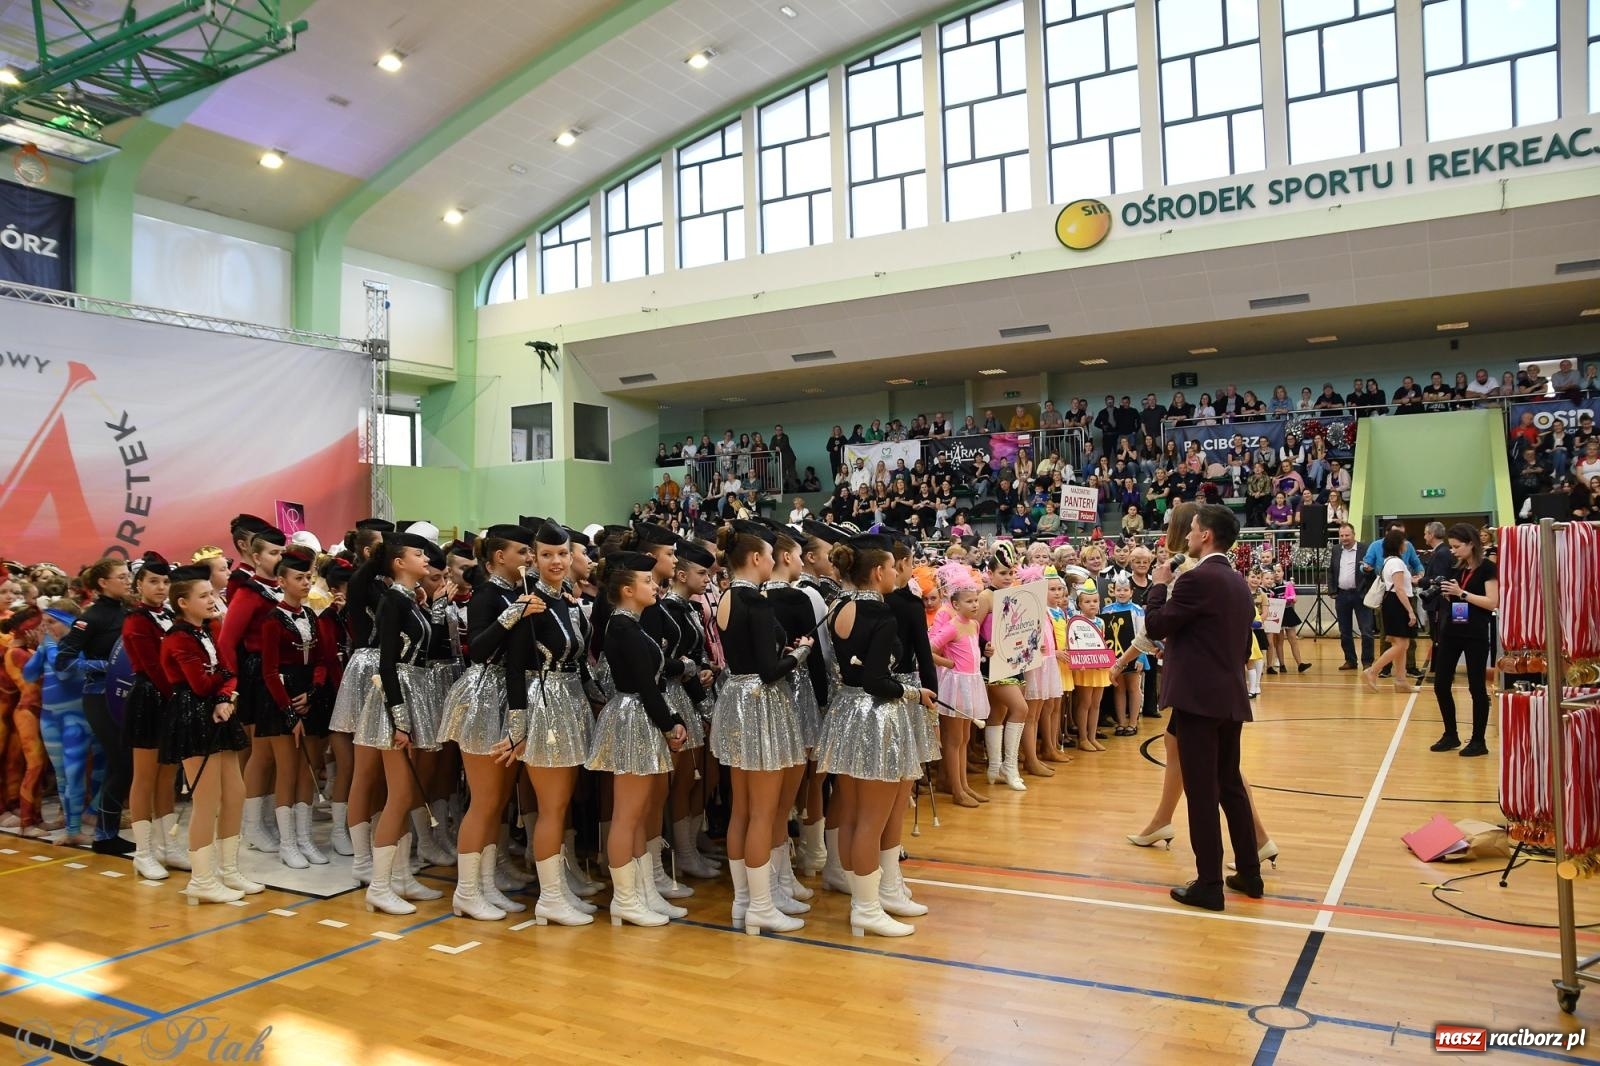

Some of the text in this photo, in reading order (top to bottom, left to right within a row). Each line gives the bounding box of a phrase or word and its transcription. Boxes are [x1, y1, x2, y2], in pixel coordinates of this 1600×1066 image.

[1121, 127, 1600, 227] OŚRODEK SPORTU I REKREAC
[1064, 496, 1095, 509] PANTERY
